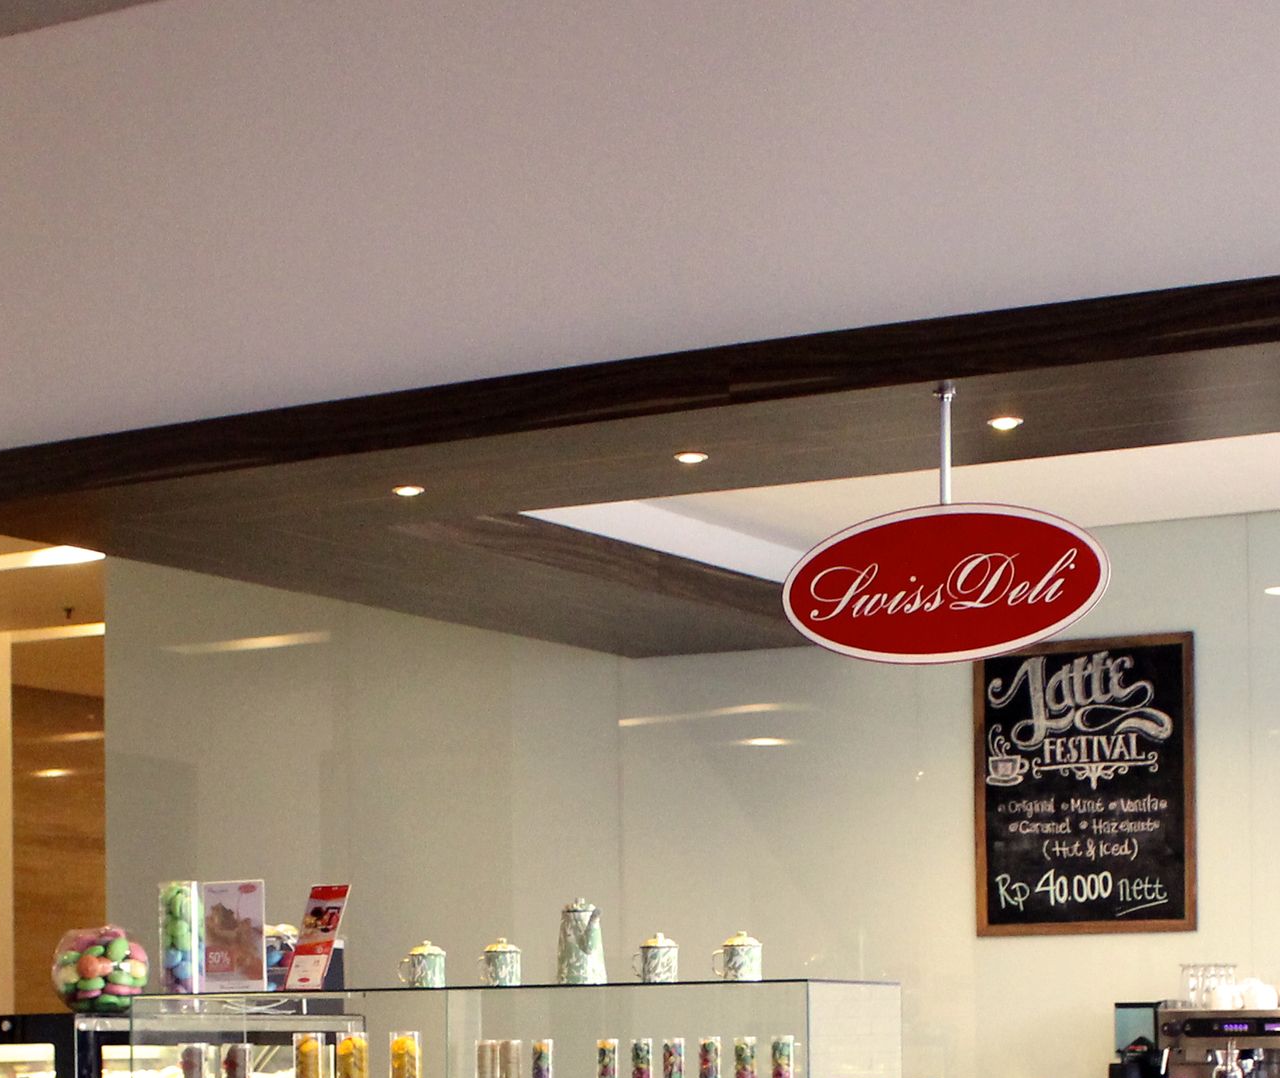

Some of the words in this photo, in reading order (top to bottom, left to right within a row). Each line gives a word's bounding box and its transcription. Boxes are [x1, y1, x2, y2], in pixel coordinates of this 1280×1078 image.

[810, 563, 945, 621] Swiss
[946, 548, 1078, 611] Deli
[988, 651, 1154, 750] Latte
[1043, 732, 1145, 763] FESTIVAL
[1008, 796, 1056, 818] Original
[1071, 796, 1105, 813] Mint
[995, 873, 1030, 911] Rp
[1035, 868, 1113, 906] 40.000
[1118, 877, 1168, 902] nett
